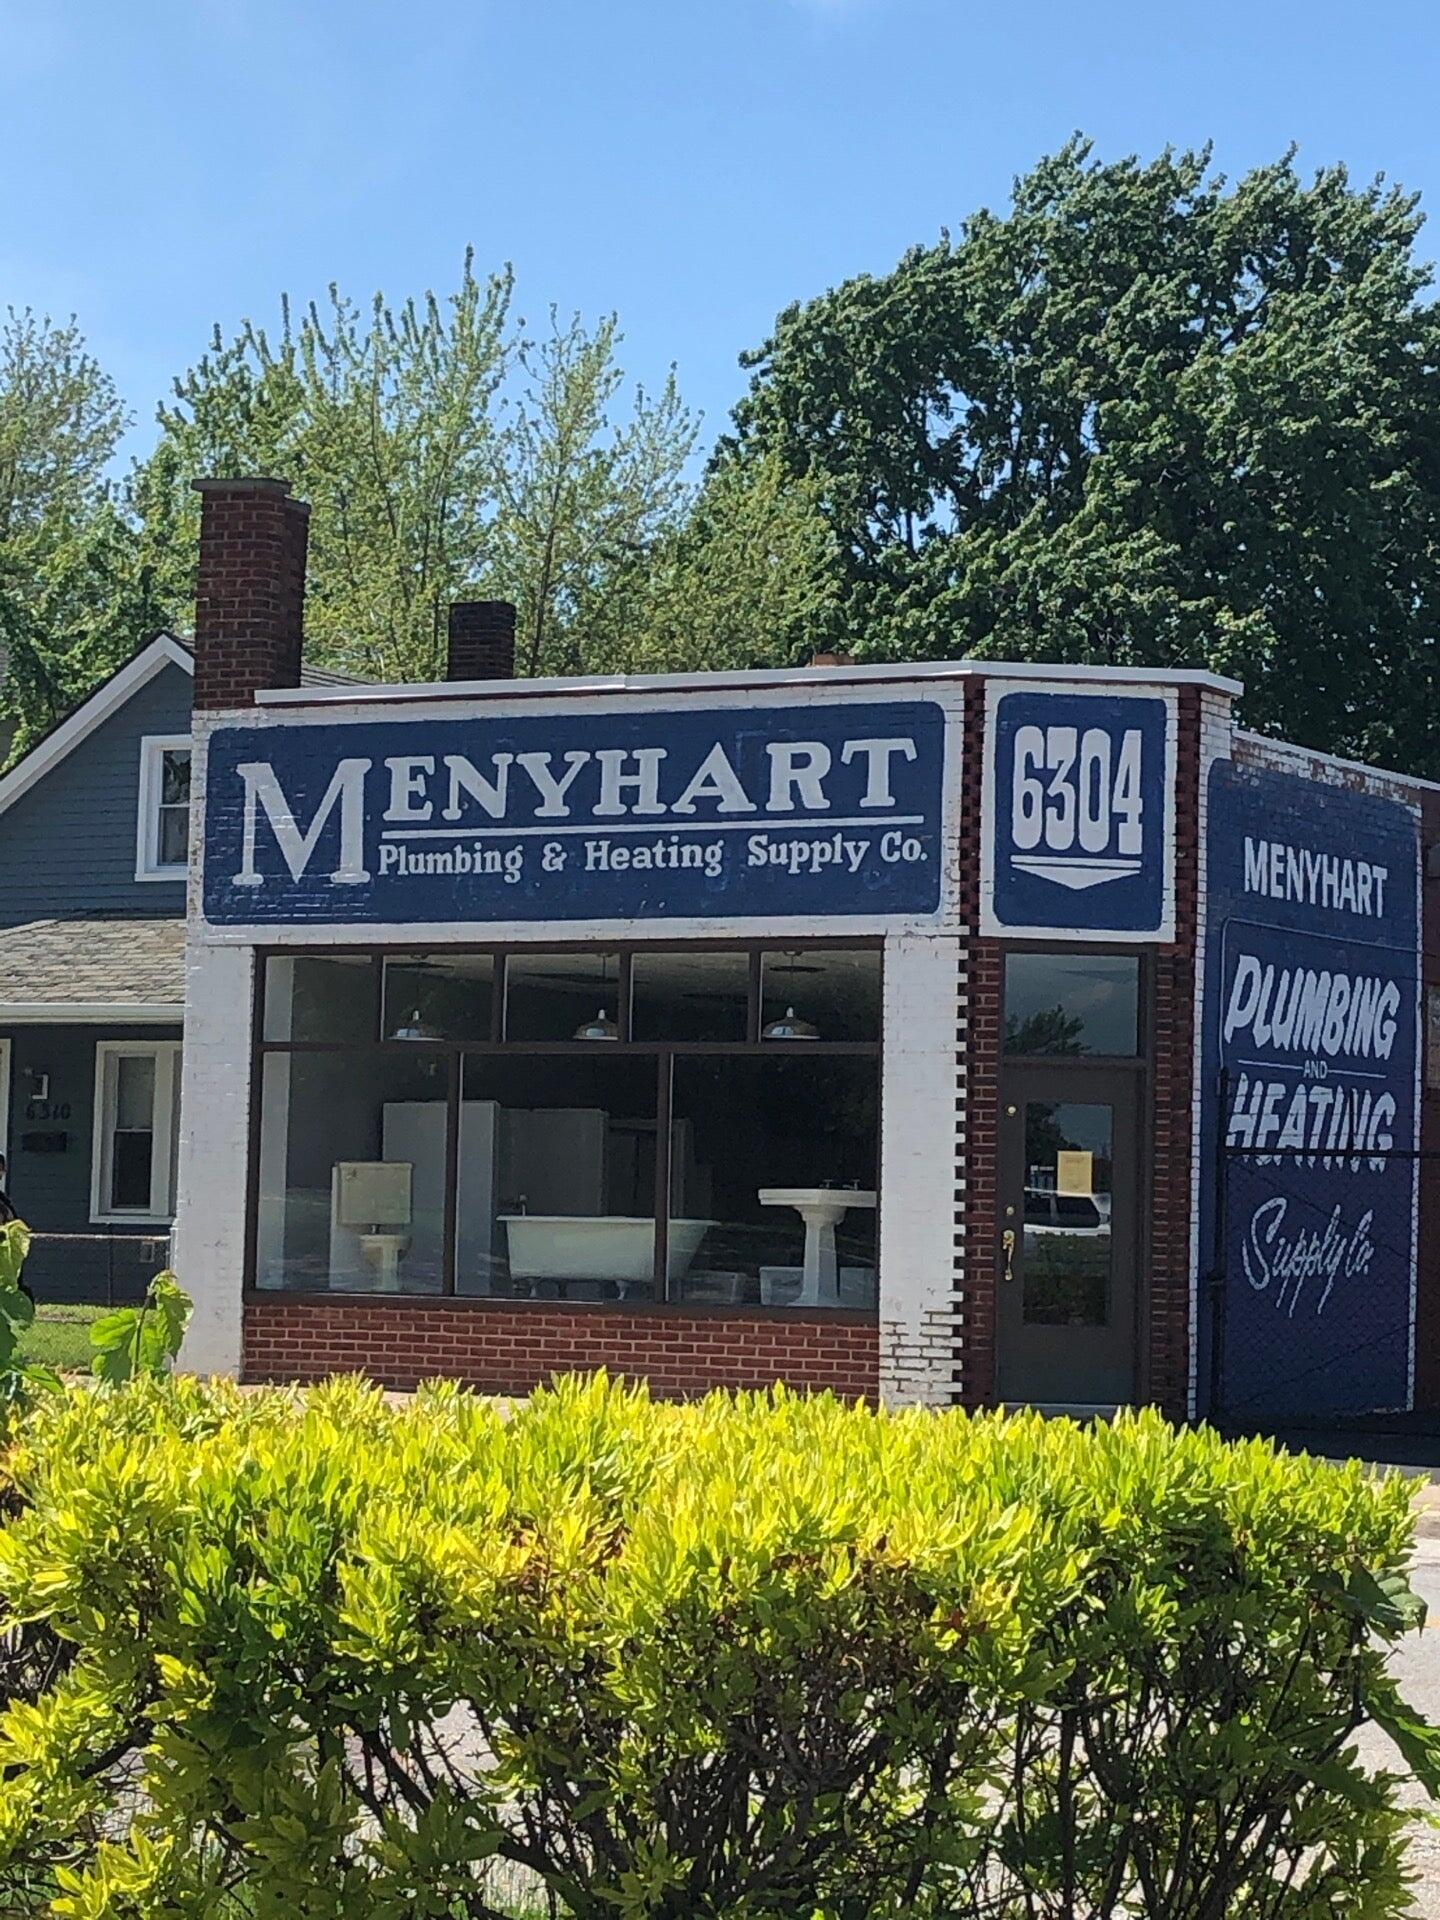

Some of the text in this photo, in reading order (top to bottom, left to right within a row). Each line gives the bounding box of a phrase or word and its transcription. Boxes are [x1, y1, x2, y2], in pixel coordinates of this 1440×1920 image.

[233, 738, 917, 885] MENYHART
[1012, 725, 1143, 855] 6304
[378, 831, 928, 884] Plumbing & Heating Supply Co.
[1244, 836, 1388, 918] MENYHART
[1224, 954, 1400, 1060] PLUMBING
[1303, 1060, 1328, 1079] AND
[1225, 1072, 1396, 1173] HEATING
[1242, 1197, 1347, 1318] Supply
